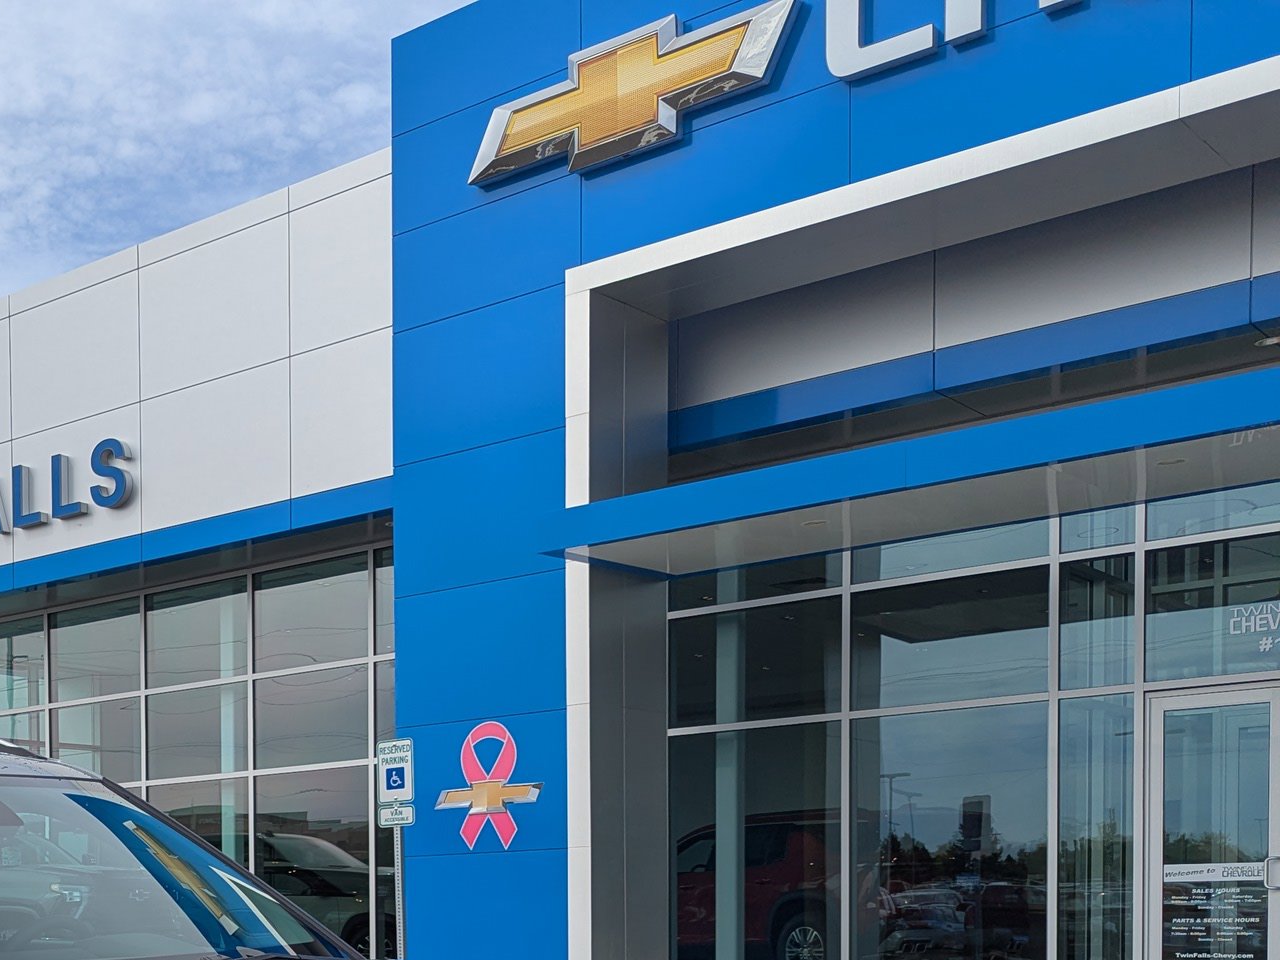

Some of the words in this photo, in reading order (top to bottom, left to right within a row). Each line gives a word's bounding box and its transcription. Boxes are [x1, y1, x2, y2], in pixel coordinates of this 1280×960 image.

[379, 744, 410, 755] RESERVED
[381, 755, 408, 766] PARKING
[390, 809, 402, 817] VAN
[1165, 869, 1205, 878] Welcome
[1175, 952, 1254, 960] TwinFalls-Chevy.com
